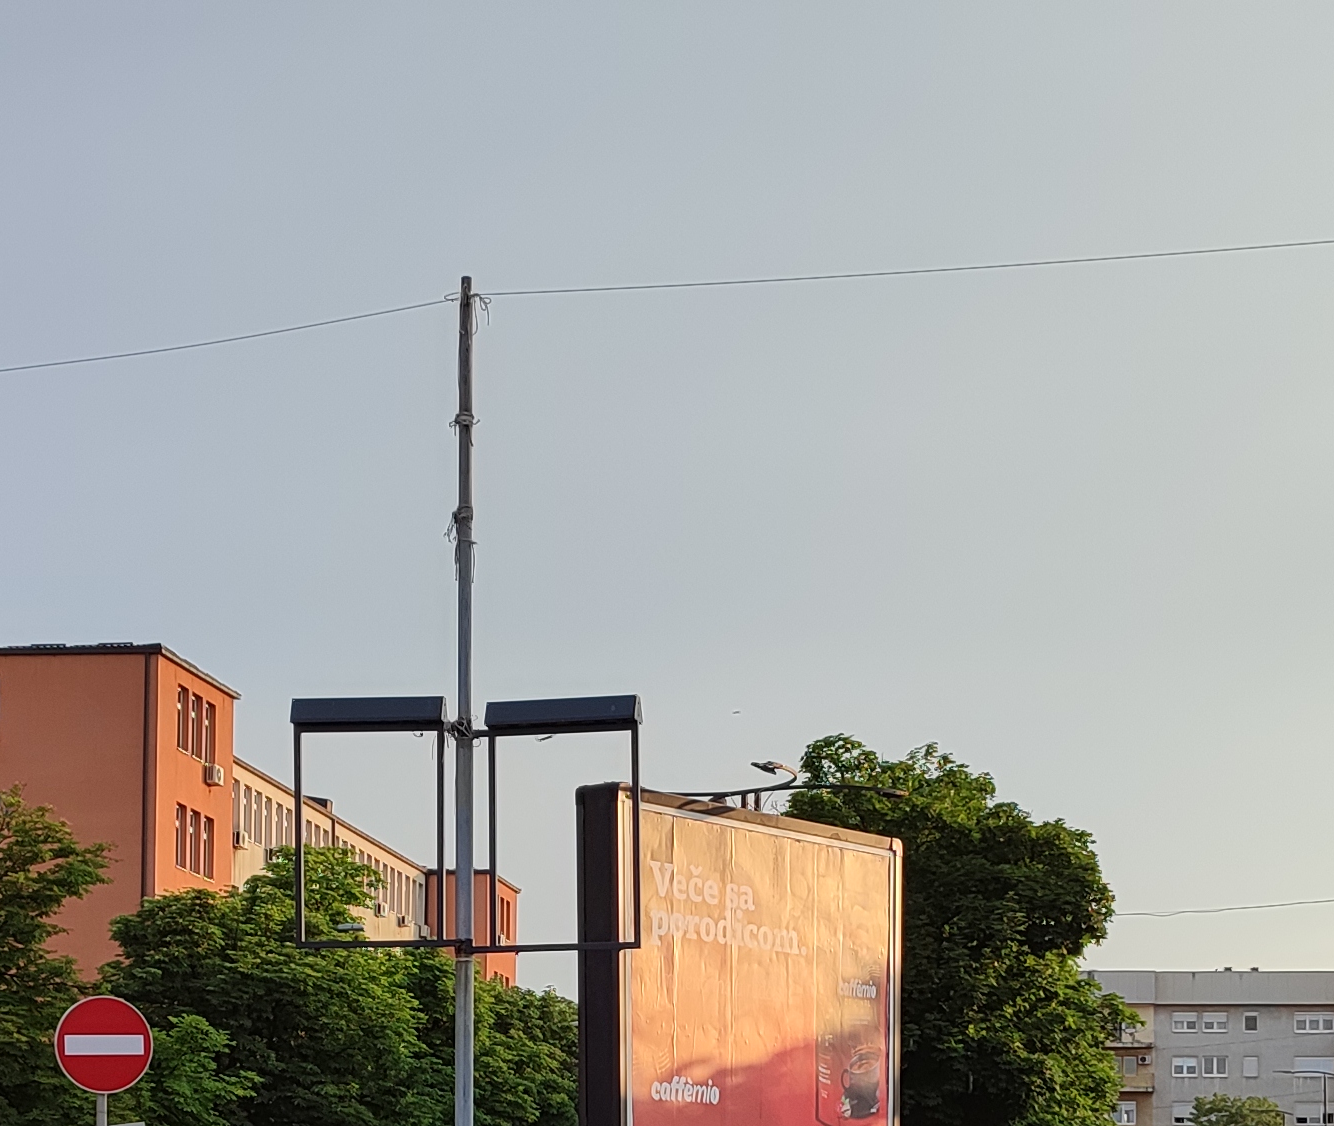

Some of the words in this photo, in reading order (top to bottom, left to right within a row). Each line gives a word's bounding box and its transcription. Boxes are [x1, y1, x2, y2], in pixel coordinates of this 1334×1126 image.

[649, 860, 718, 905] Veče
[725, 883, 756, 912] sa
[650, 908, 807, 957] porodicom.
[651, 1075, 720, 1105] caffèmio
